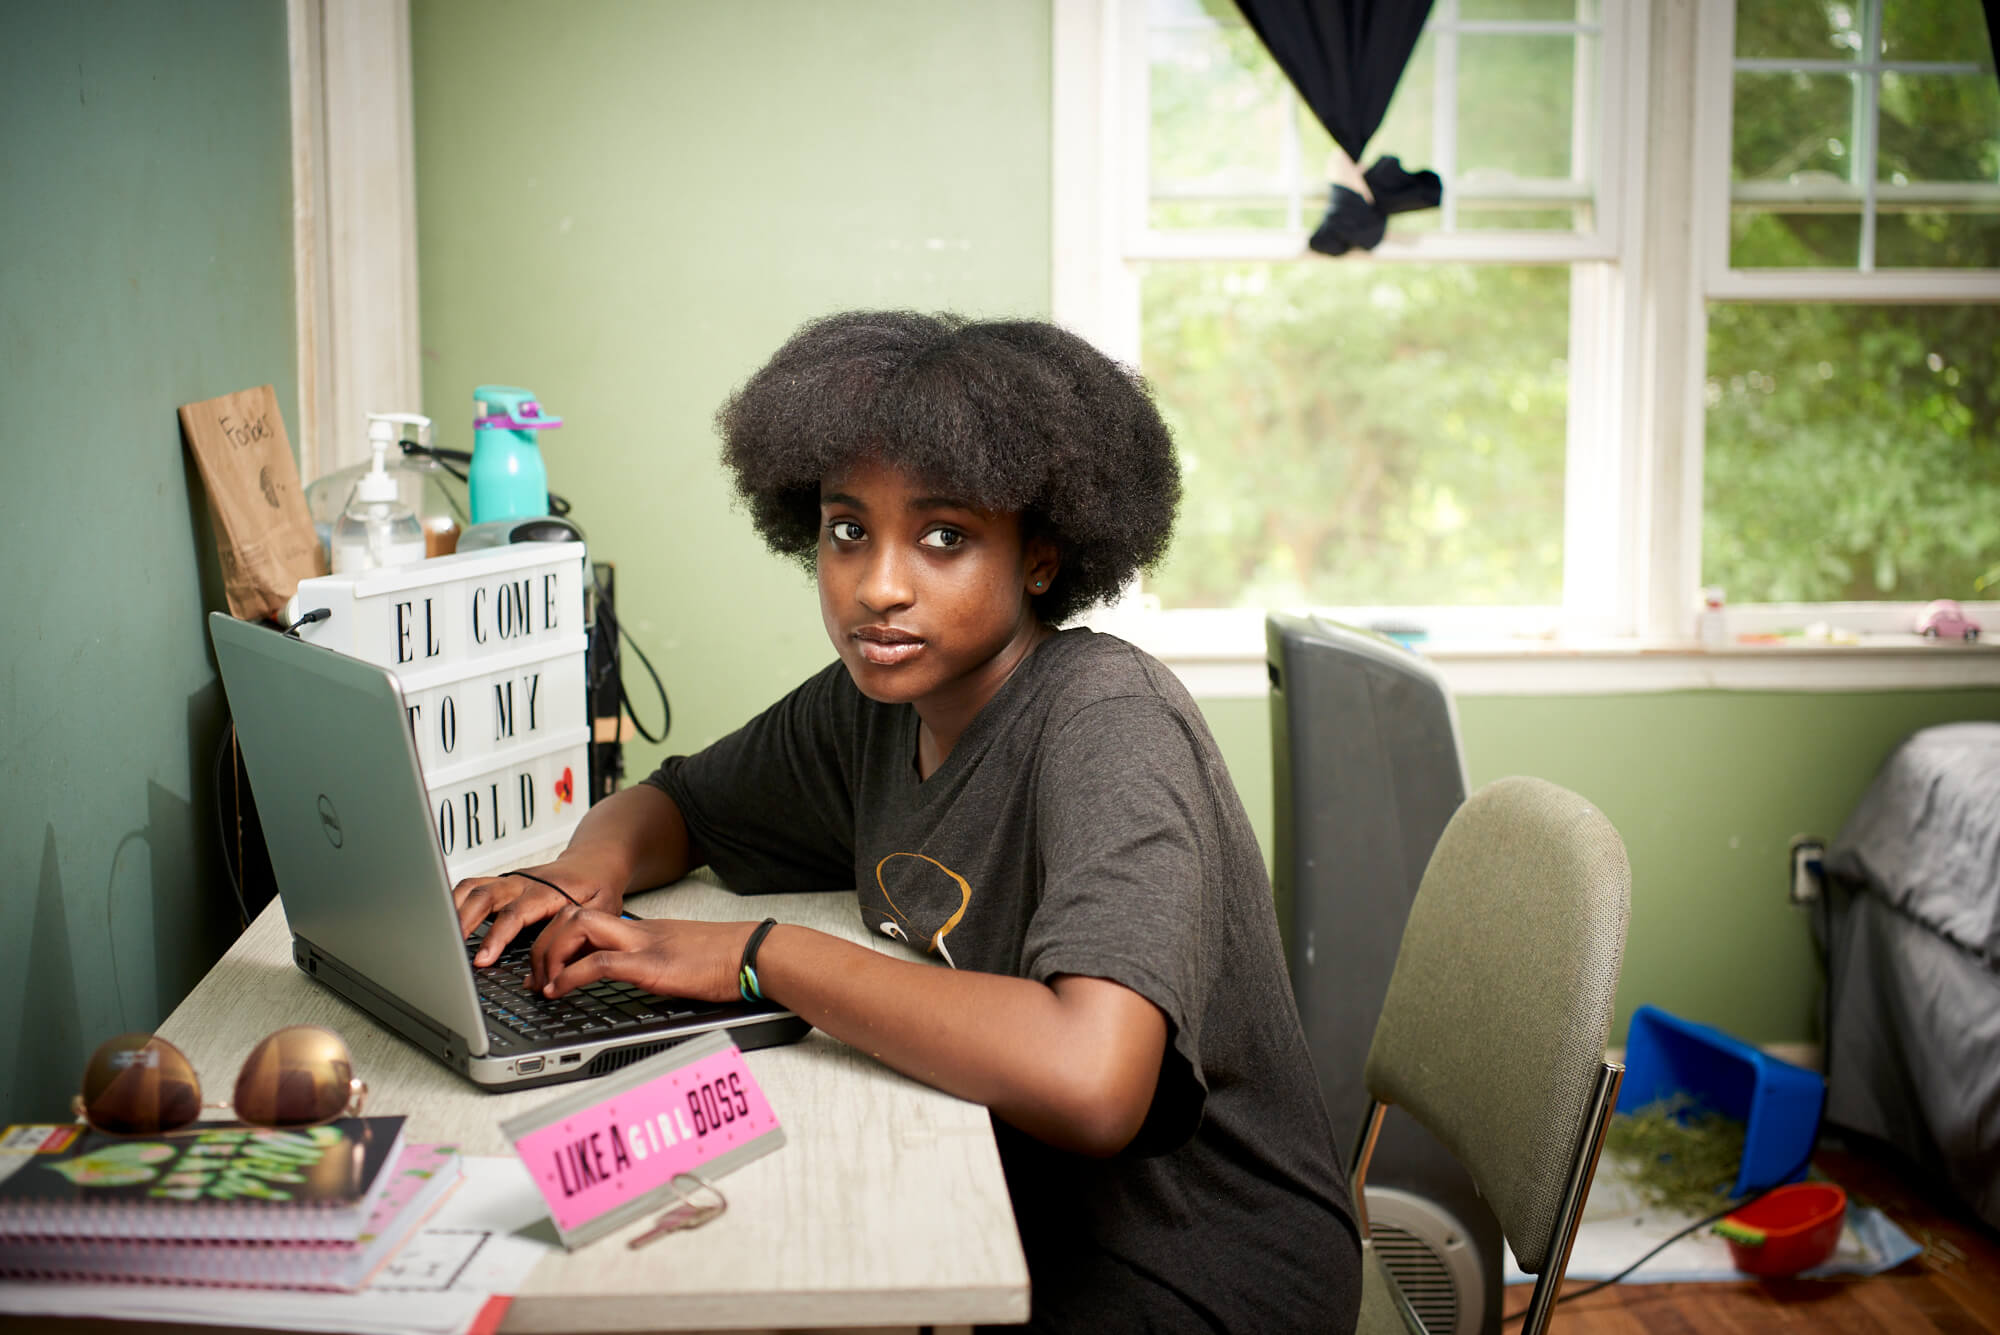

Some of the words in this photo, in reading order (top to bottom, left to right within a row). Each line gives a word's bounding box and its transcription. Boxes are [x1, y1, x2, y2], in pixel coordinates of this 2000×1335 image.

[218, 410, 275, 450] Forbes
[394, 597, 441, 664] EL
[473, 573, 558, 645] COME
[494, 673, 541, 741] MY
[554, 1132, 611, 1199] LIKE
[609, 1124, 631, 1174] A
